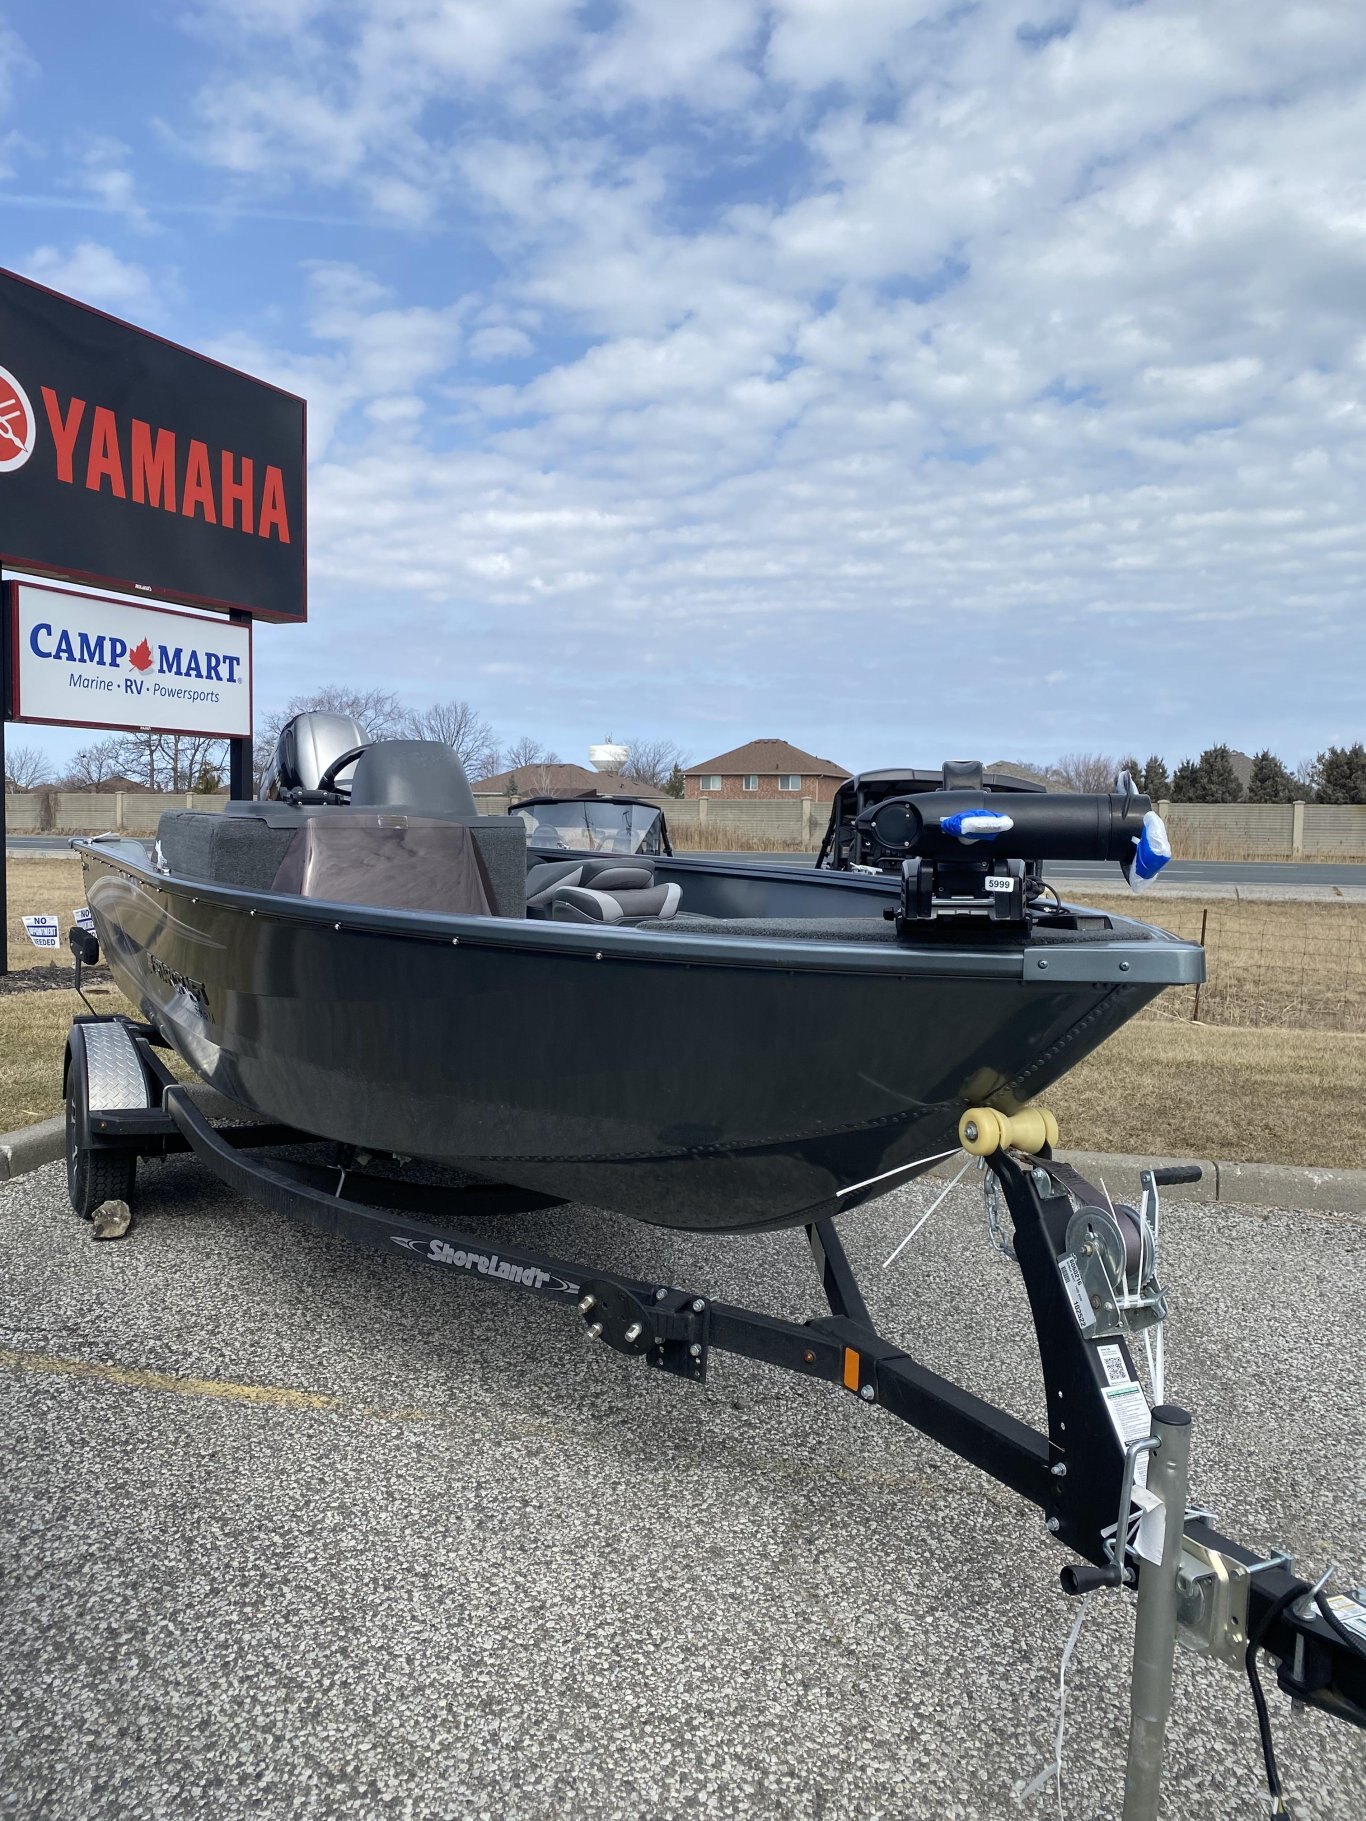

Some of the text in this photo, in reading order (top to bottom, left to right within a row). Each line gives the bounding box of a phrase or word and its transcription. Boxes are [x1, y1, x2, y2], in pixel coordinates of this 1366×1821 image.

[41, 386, 290, 544] YAMAHA
[30, 623, 241, 683] CAMP MART
[69, 673, 220, 703] Marine RV Powersports
[989, 880, 1010, 888] 5999
